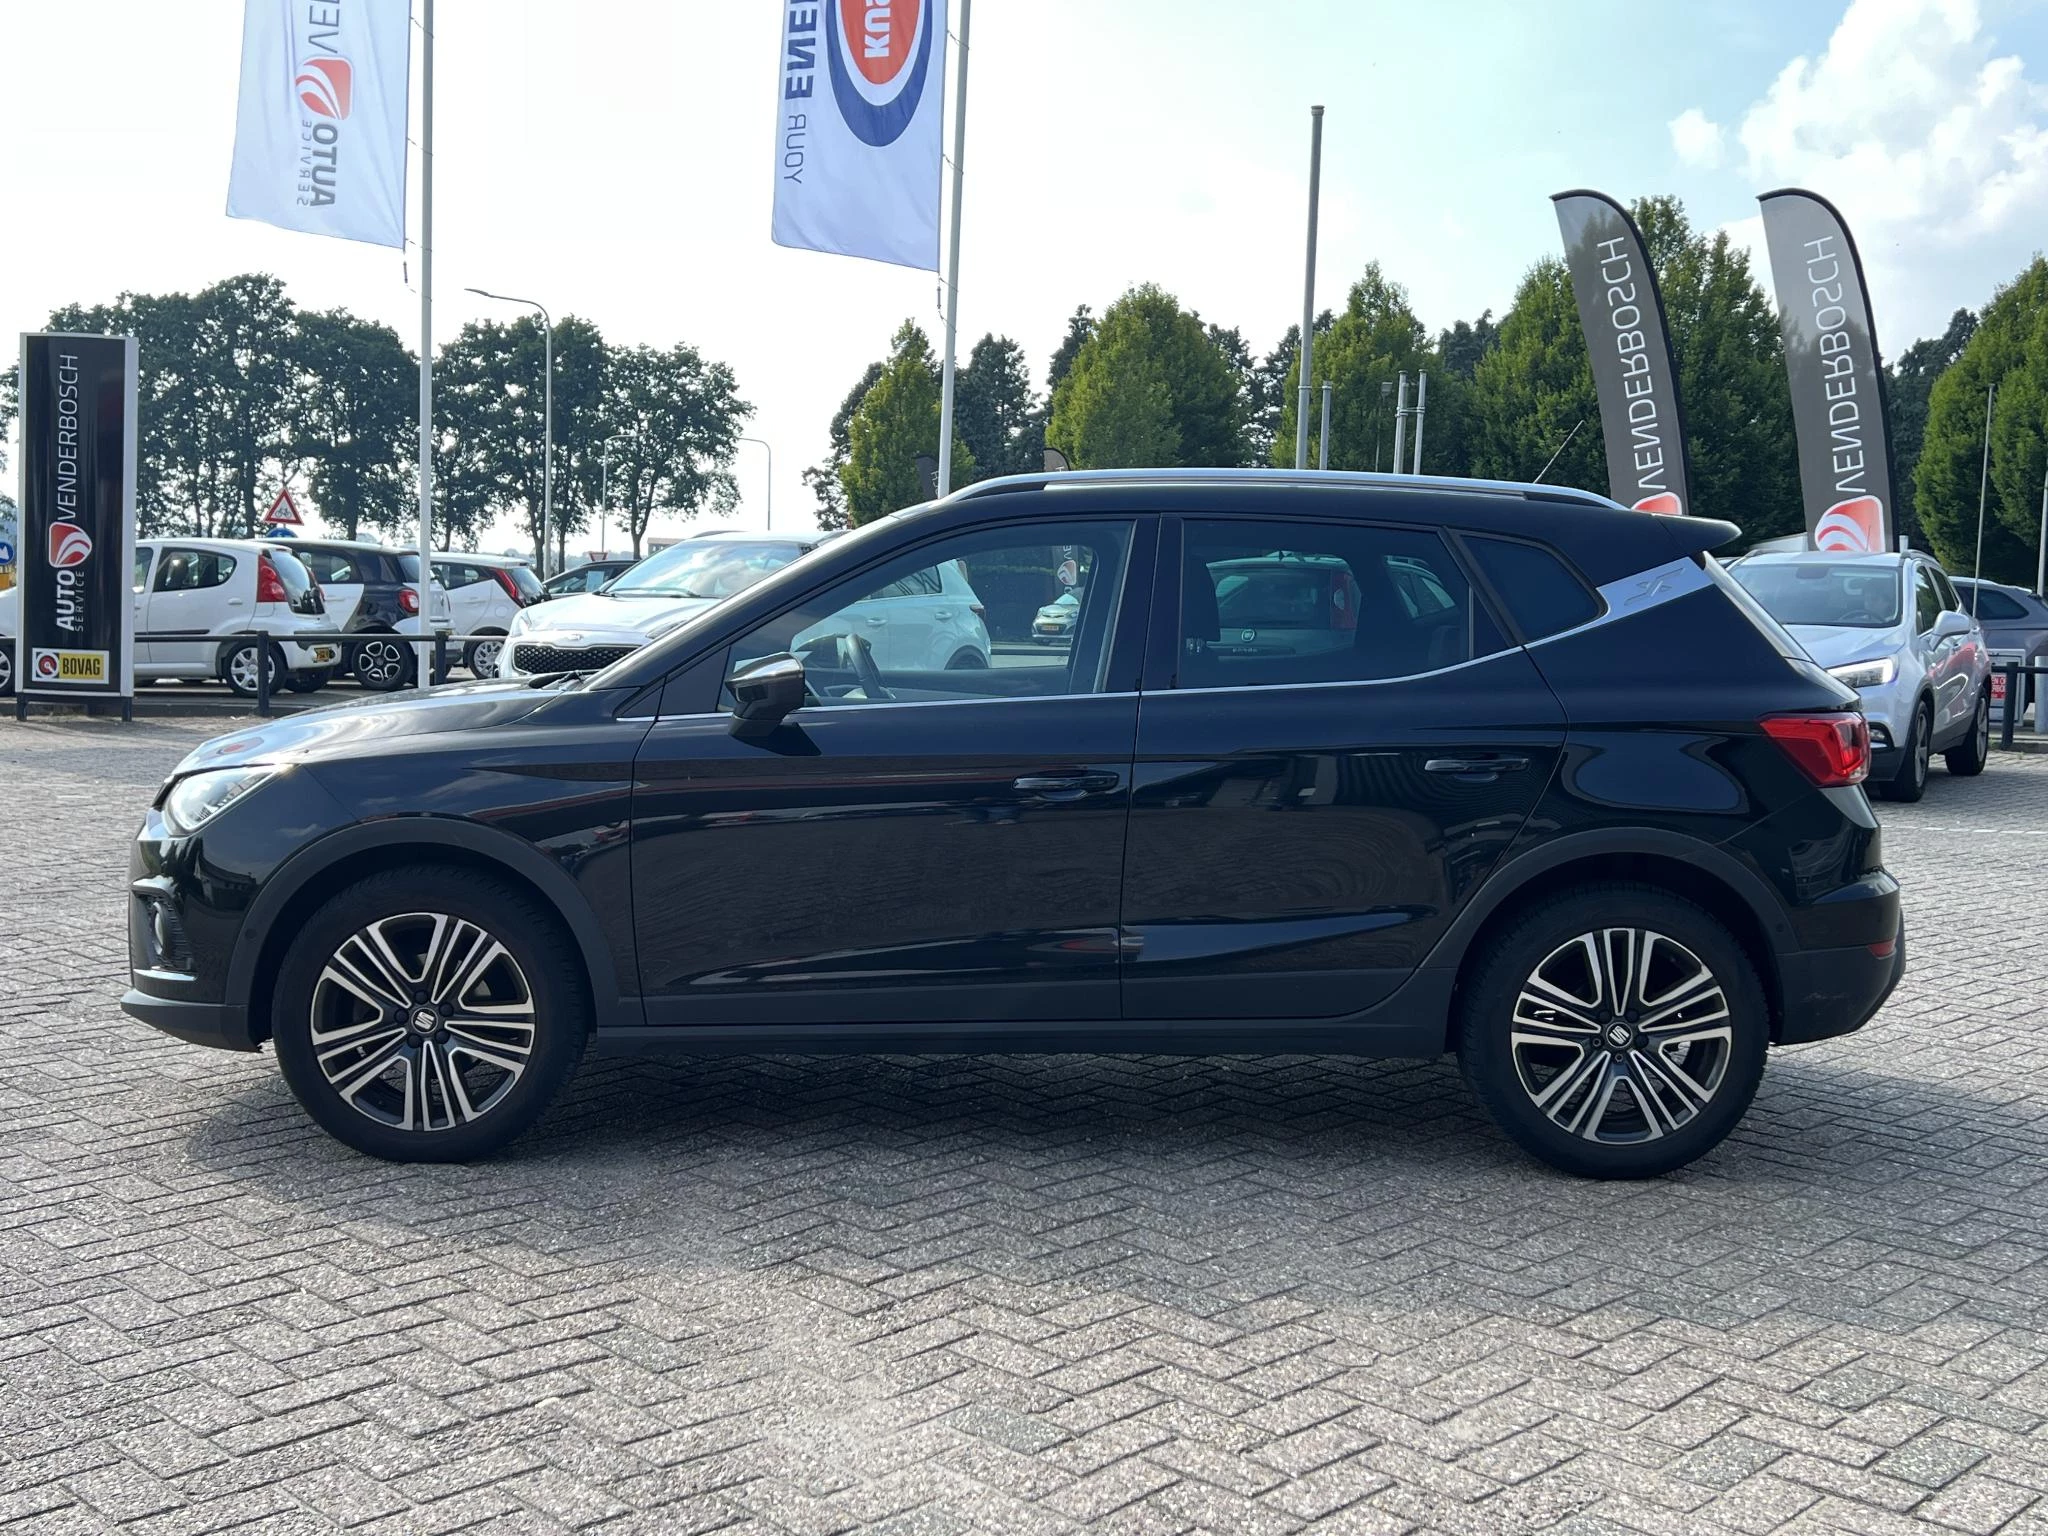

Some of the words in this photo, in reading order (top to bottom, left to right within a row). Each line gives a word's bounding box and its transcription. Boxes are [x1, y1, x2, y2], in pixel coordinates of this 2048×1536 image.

[57, 354, 79, 521] VENDERBOSCH
[56, 569, 76, 632] AUTO
[75, 570, 85, 633] SERVICE
[62, 657, 100, 676] BOVAG
